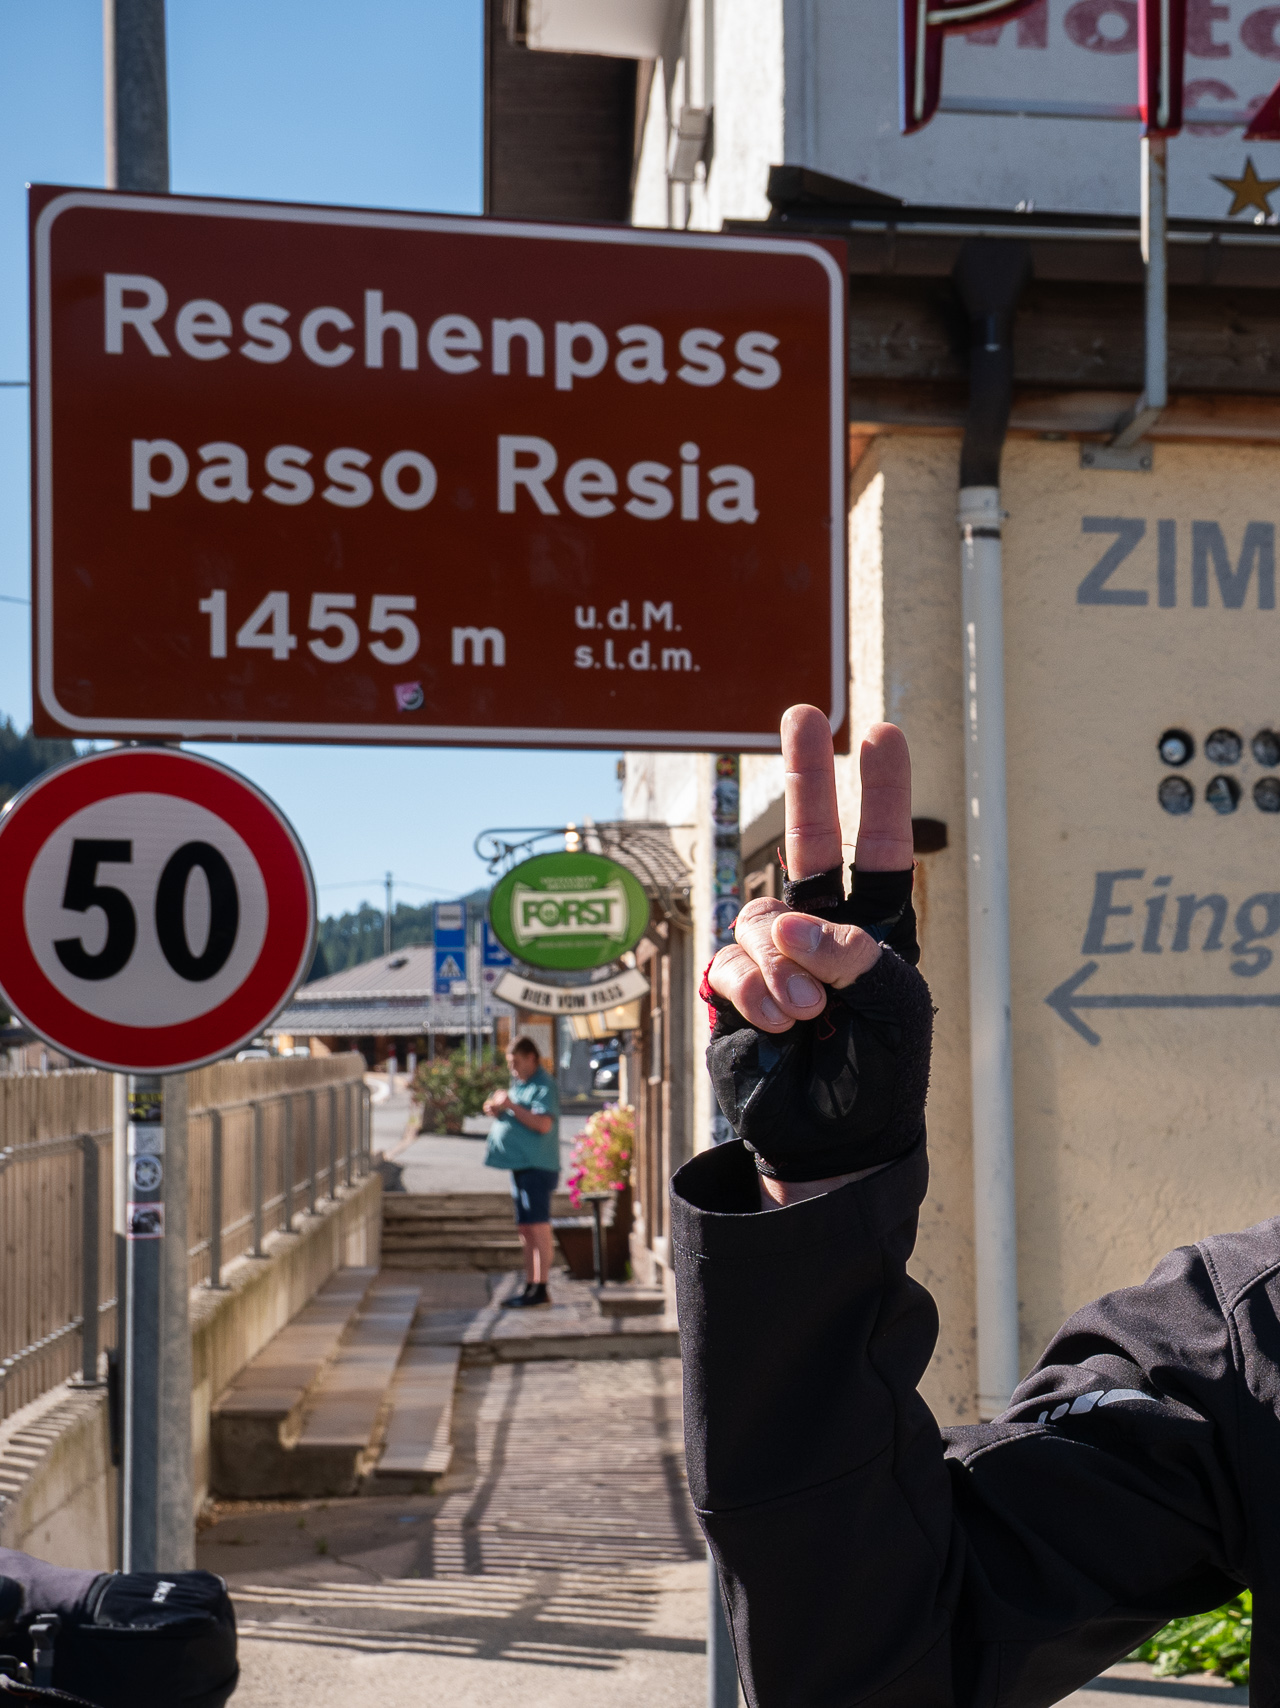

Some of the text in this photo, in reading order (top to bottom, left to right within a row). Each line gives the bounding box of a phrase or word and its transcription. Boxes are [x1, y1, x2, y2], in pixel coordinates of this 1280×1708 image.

[103, 272, 782, 391] Reschenpass
[131, 434, 760, 524] passo Resia
[199, 589, 506, 666] 1455 m
[574, 599, 683, 632] u.d.M.
[574, 638, 702, 672] s.l.d.m.
[54, 838, 240, 982] 50
[523, 899, 617, 927] FORST
